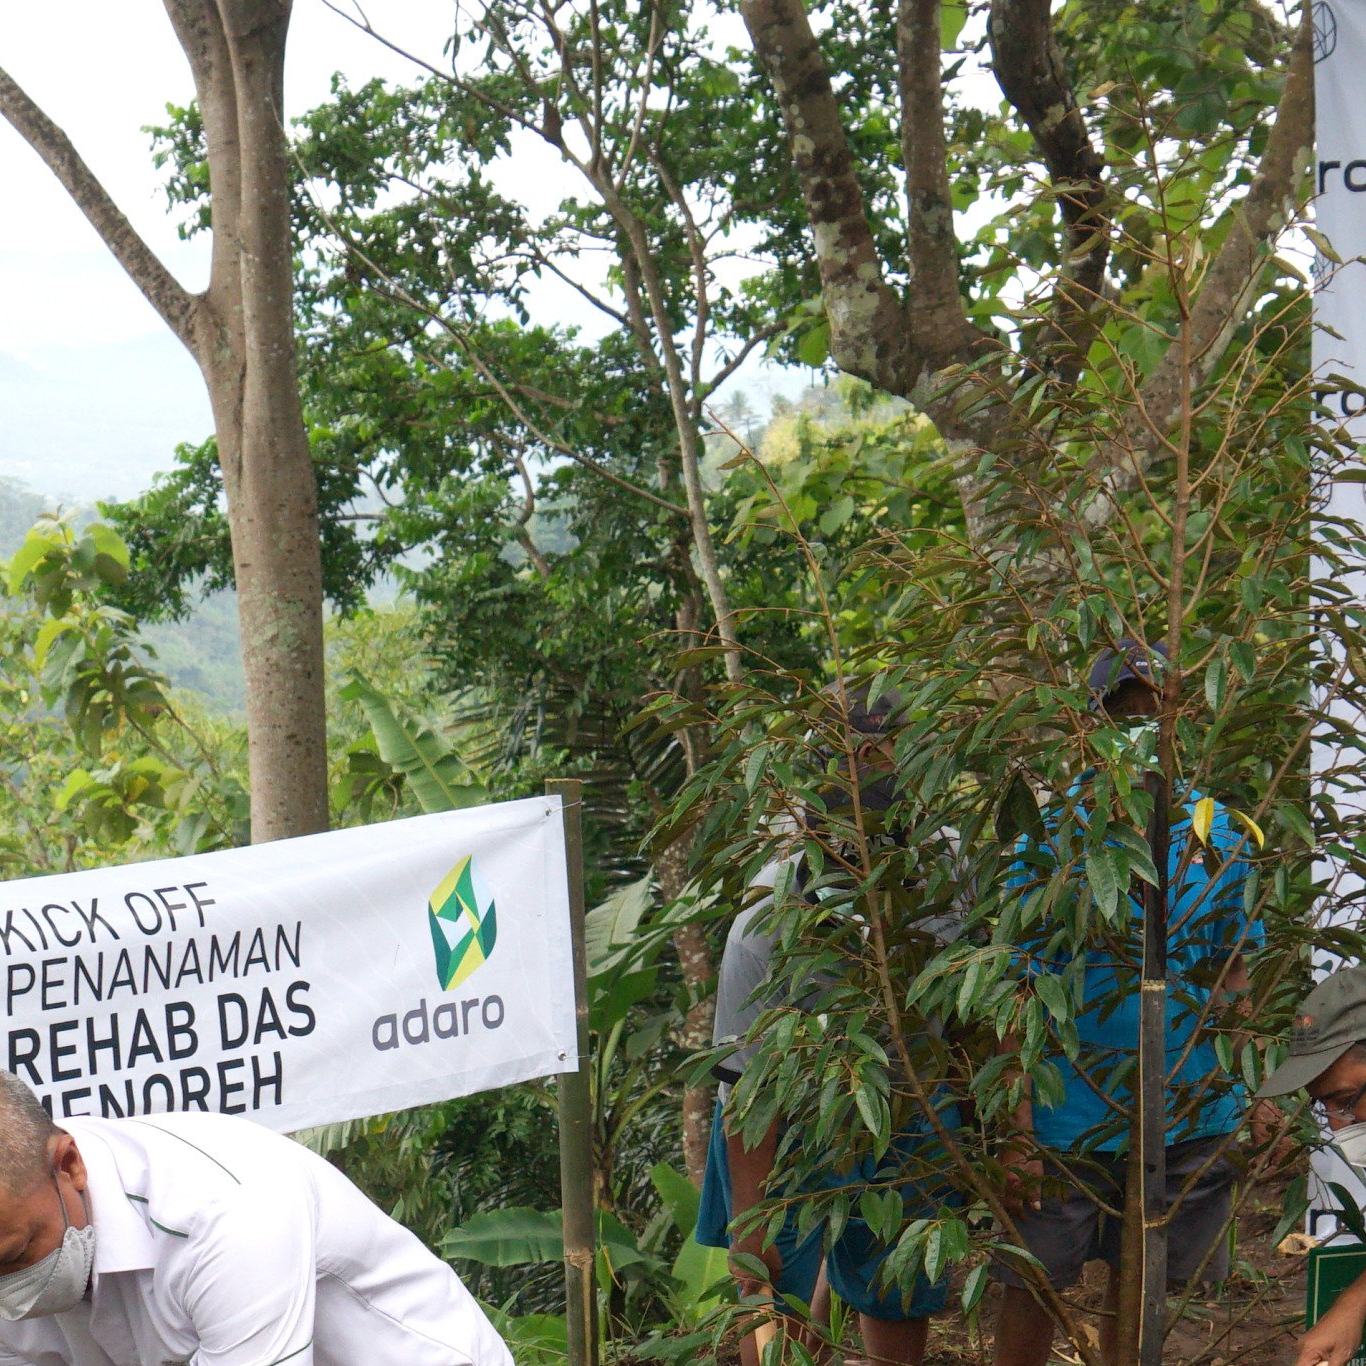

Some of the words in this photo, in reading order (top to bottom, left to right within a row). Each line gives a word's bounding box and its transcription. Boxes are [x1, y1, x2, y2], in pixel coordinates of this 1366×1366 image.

[124, 881, 216, 936] OFF
[7, 920, 302, 1017] PENANAMAN
[8, 1000, 199, 1086] REHAB
[217, 980, 317, 1051] DAS
[371, 993, 505, 1052] adaro
